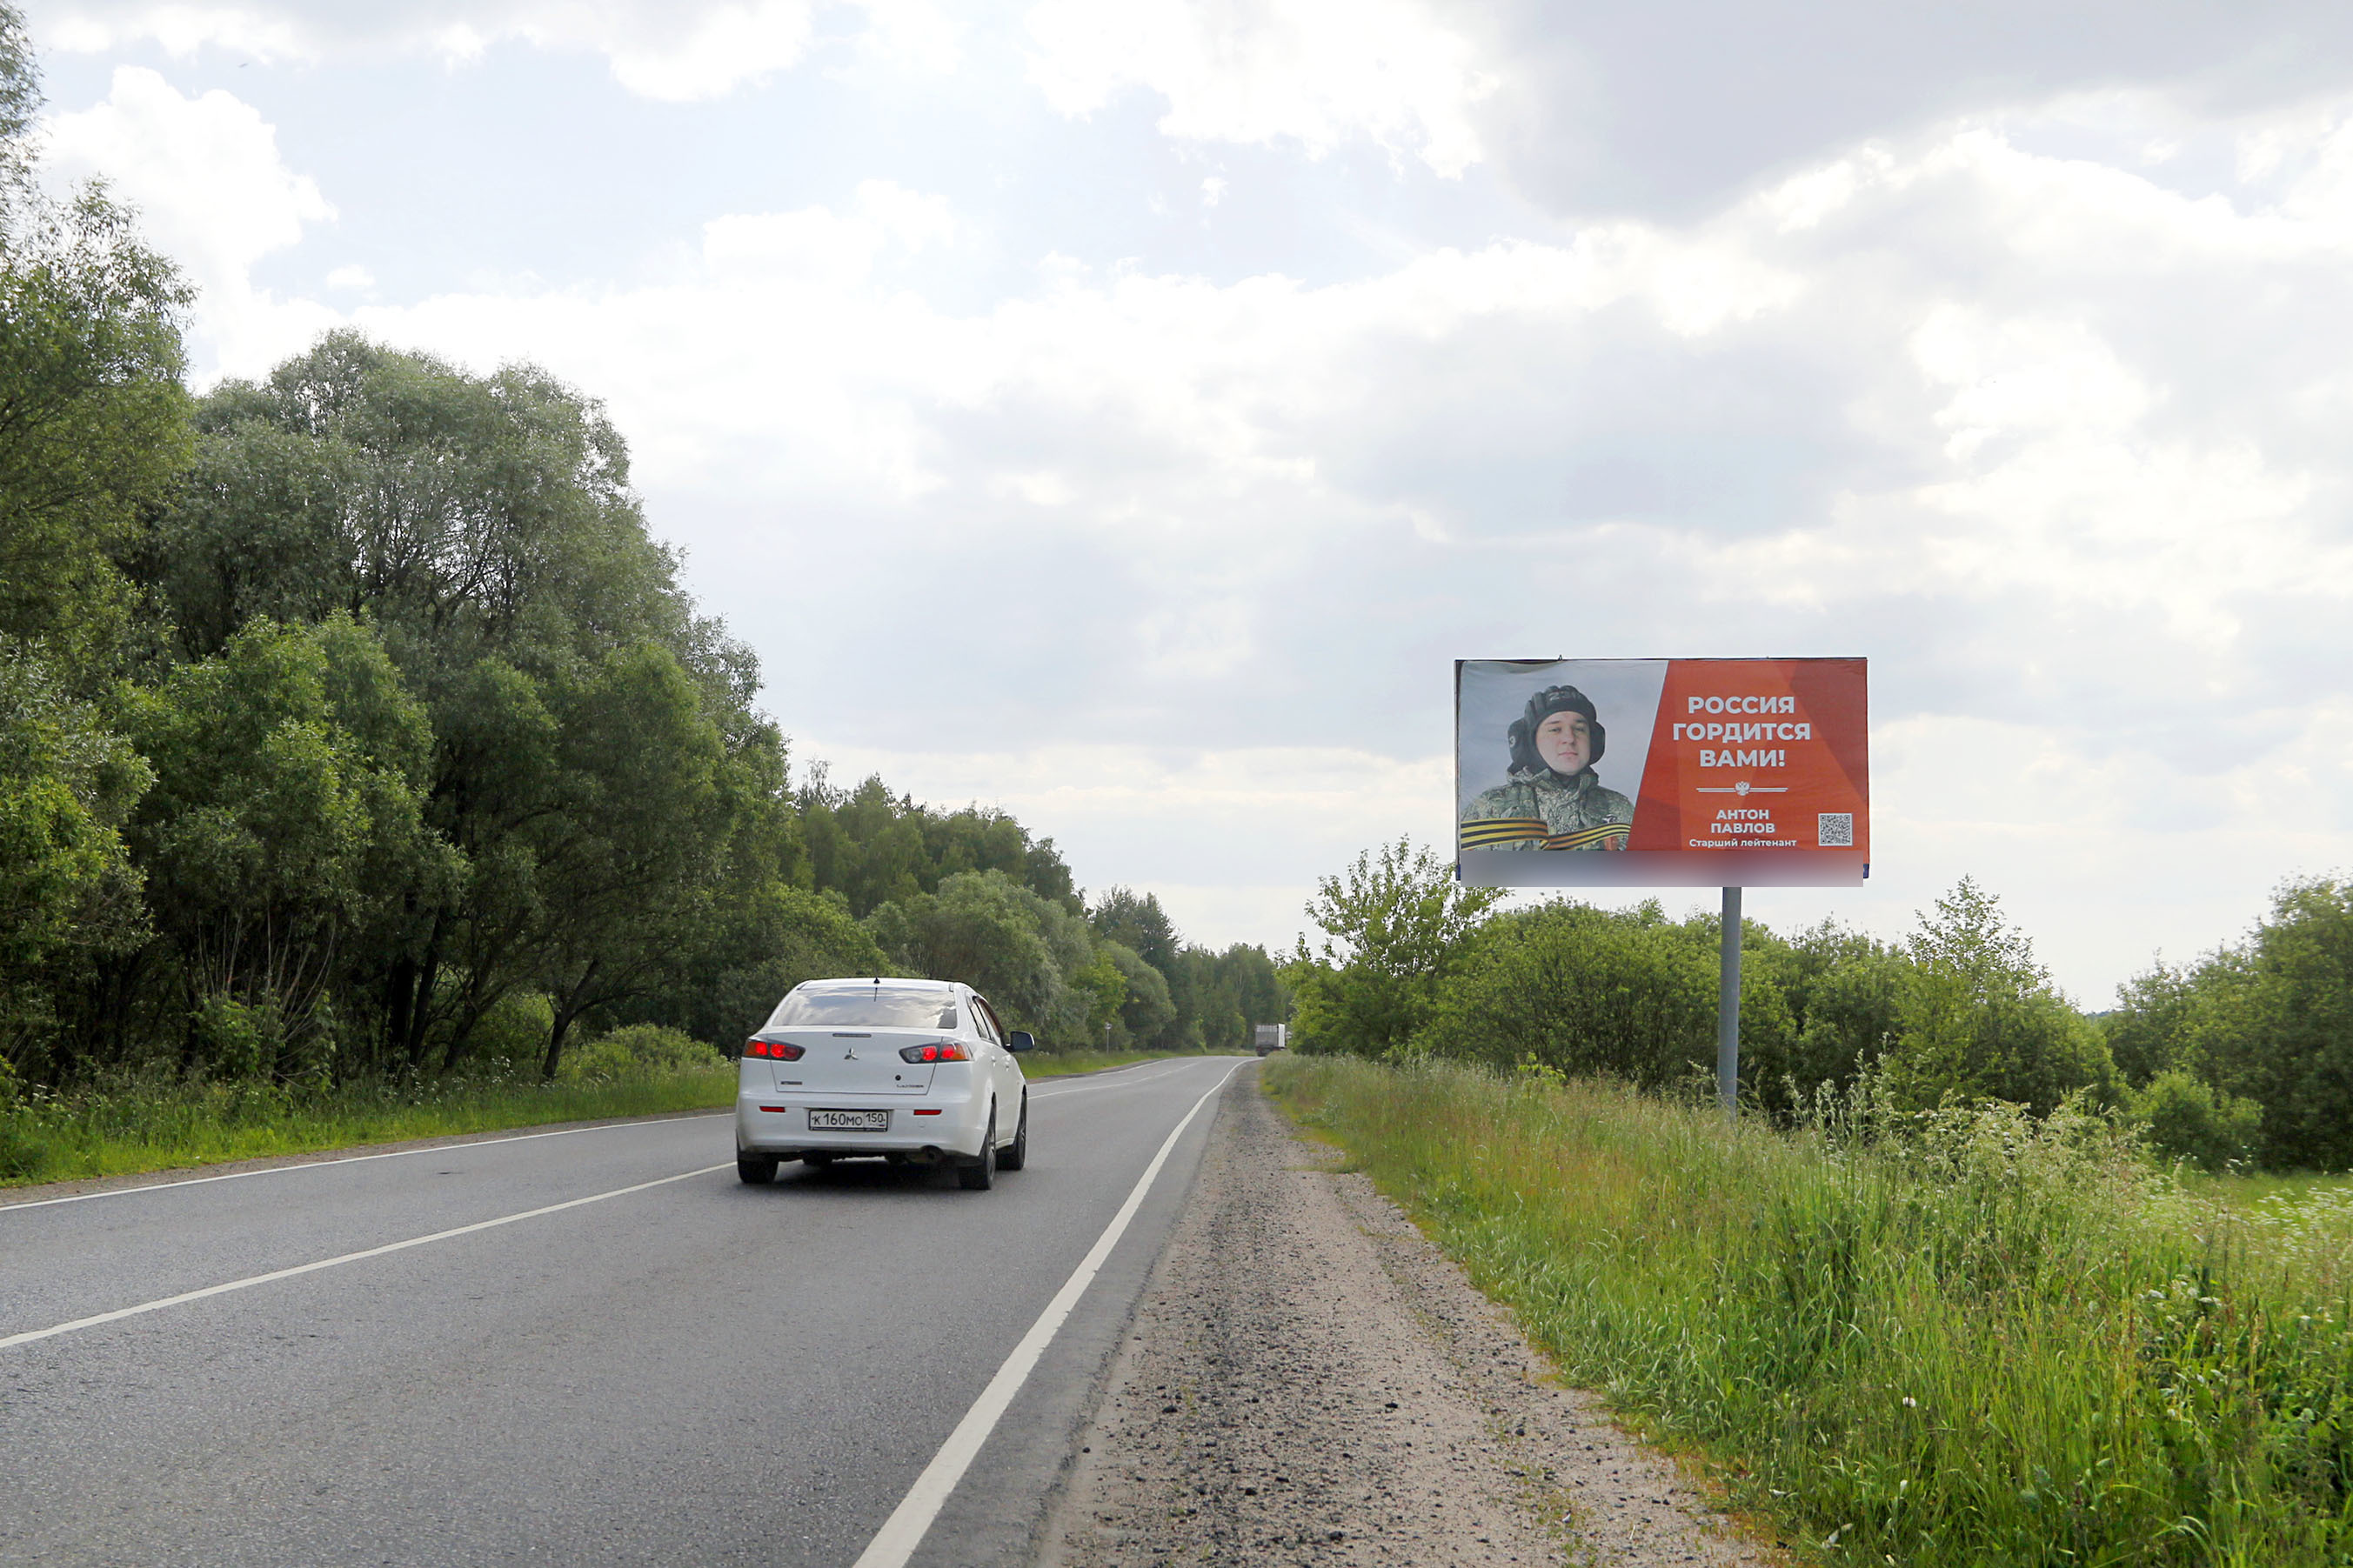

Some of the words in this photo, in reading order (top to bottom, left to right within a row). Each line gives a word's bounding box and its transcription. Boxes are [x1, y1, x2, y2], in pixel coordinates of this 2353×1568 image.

[1688, 697, 1795, 714] РОССИЯ
[1672, 723, 1810, 744] ГОРДИТСЯ
[1699, 750, 1786, 767] ВАМИ!
[1715, 809, 1769, 820] АНТОН
[1710, 823, 1775, 833] ПАВЛОВ
[1688, 838, 1738, 848] Старший
[1741, 838, 1797, 847] лейтенант
[866, 1112, 884, 1123] 150
